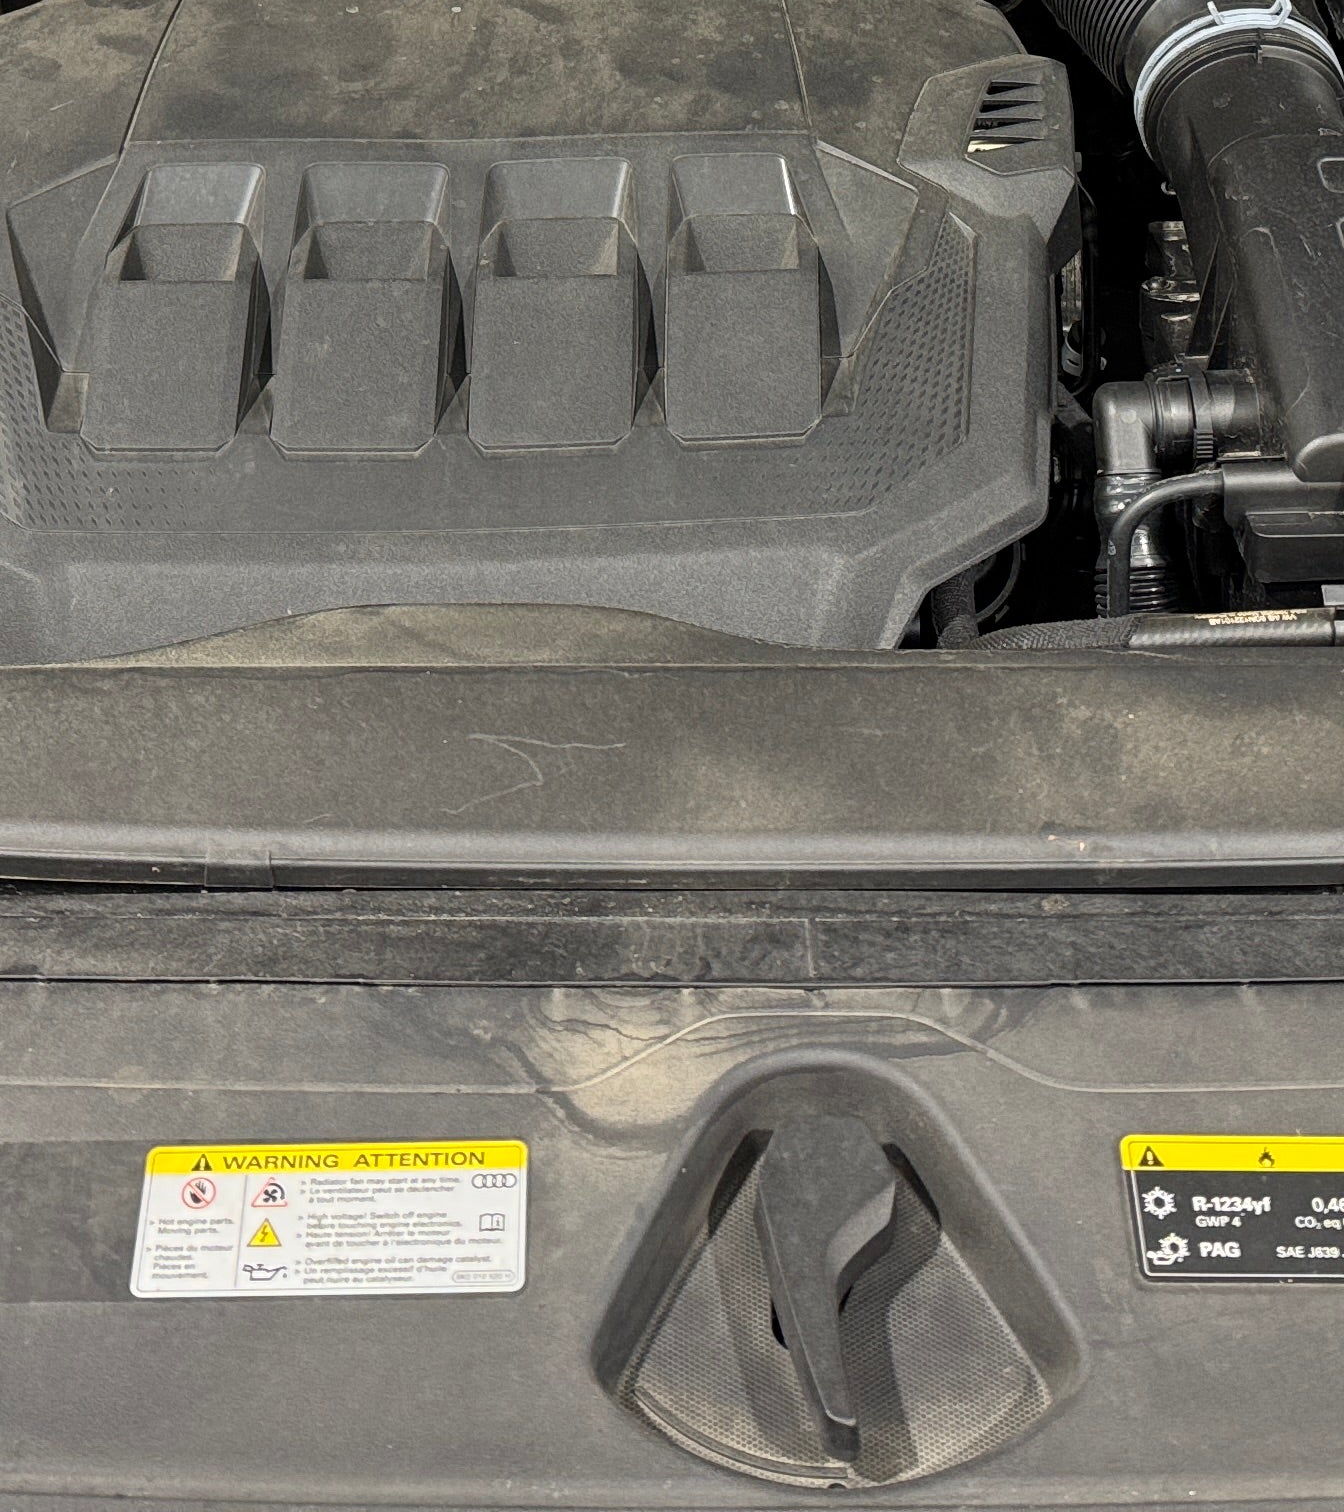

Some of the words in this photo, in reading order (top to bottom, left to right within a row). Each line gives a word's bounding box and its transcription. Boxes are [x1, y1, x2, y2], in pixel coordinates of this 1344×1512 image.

[223, 1155, 339, 1169] WARNING
[354, 1151, 485, 1167] ATTENTION
[1192, 1196, 1272, 1215] R-1234yf
[308, 1213, 328, 1221] High
[402, 1211, 415, 1219] off
[417, 1212, 447, 1220] engine
[177, 1219, 207, 1227] engine
[338, 1221, 377, 1230] touching
[380, 1221, 410, 1230] engine
[1195, 1216, 1229, 1227] GWP
[1231, 1216, 1242, 1227] 4
[1324, 1219, 1341, 1230] eq
[158, 1227, 192, 1235] Moving
[1200, 1242, 1241, 1258] PAG
[1276, 1246, 1305, 1258] SAE
[1308, 1247, 1340, 1258] J639
[305, 1257, 349, 1265] Overfilled
